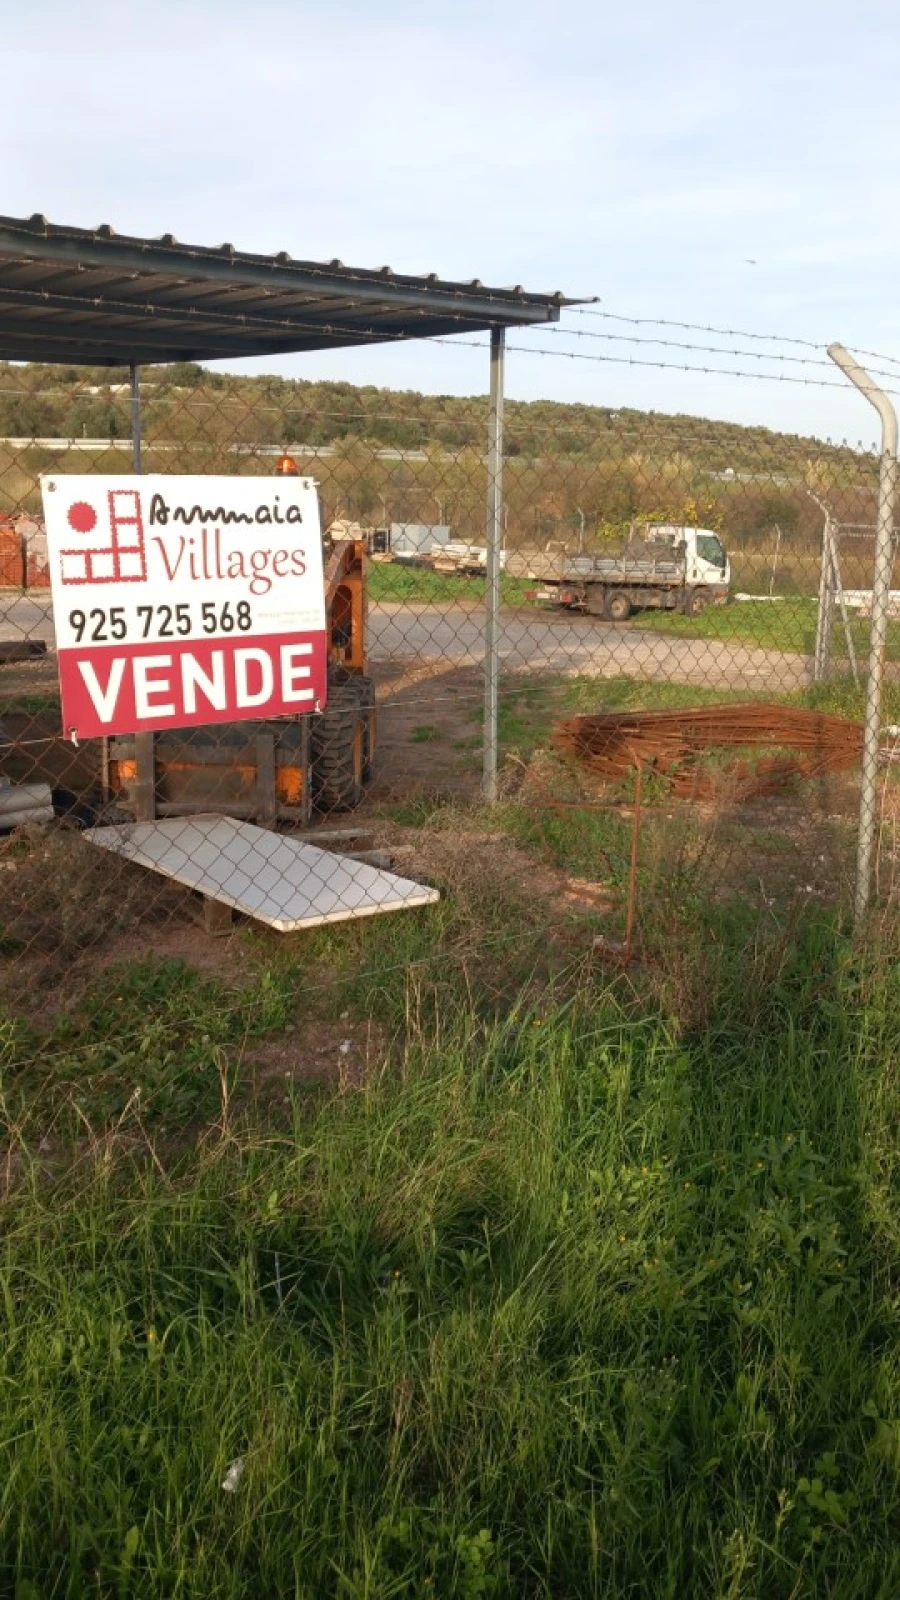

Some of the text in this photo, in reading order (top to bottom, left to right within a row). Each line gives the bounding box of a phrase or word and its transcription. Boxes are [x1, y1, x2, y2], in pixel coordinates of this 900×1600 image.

[151, 528, 307, 595] Villages
[69, 608, 127, 642] 925
[137, 604, 192, 638] 725
[201, 600, 252, 634] 568
[77, 642, 314, 723] VENDE
